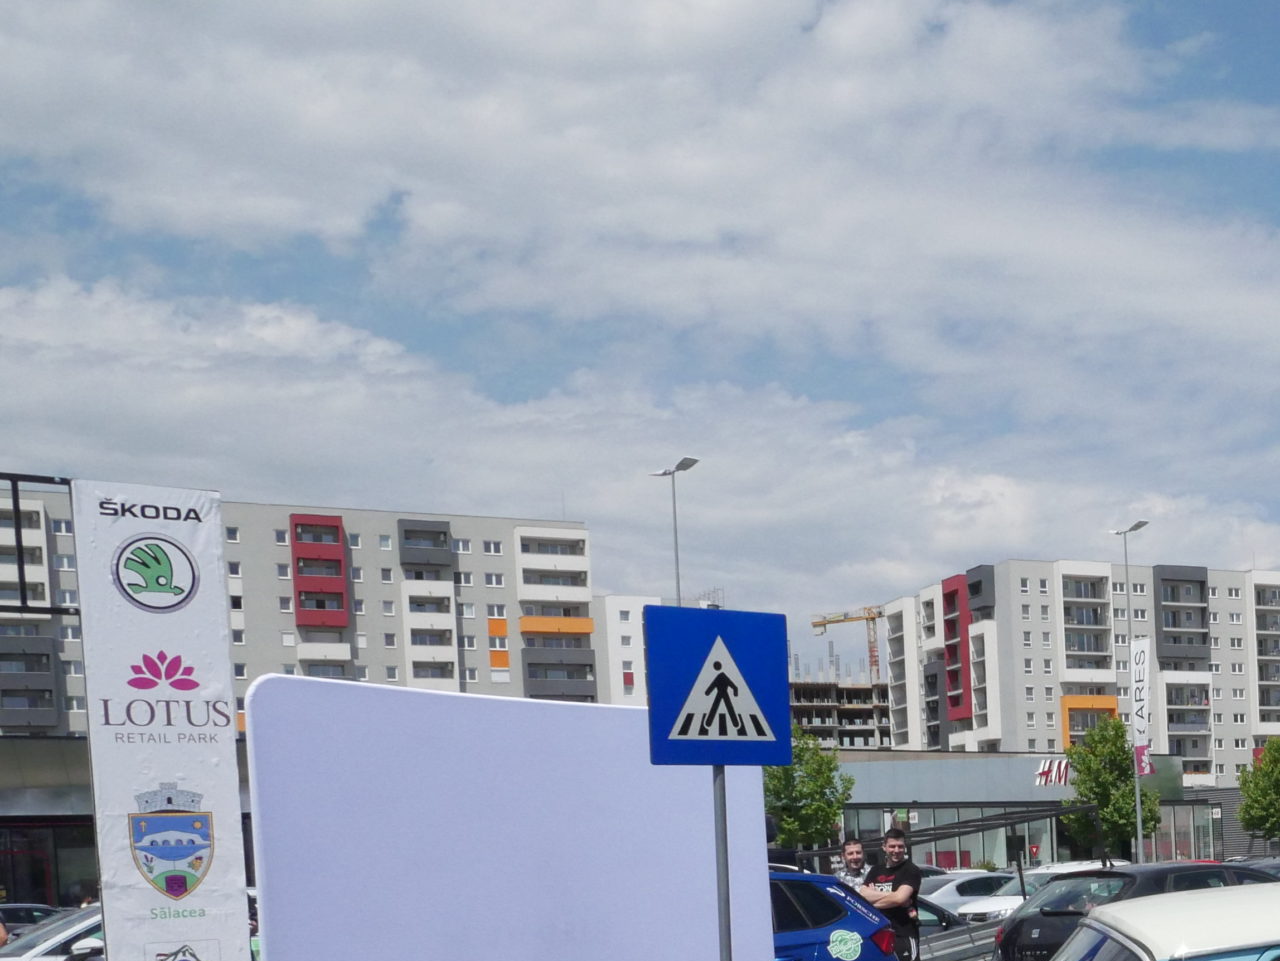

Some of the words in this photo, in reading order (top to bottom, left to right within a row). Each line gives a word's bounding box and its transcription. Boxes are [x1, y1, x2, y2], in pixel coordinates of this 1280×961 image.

[99, 498, 203, 523] ŠKODA
[1134, 650, 1146, 720] ARES
[99, 698, 231, 728] LOTUS
[115, 732, 172, 744] RETAIL
[177, 732, 219, 744] PARK
